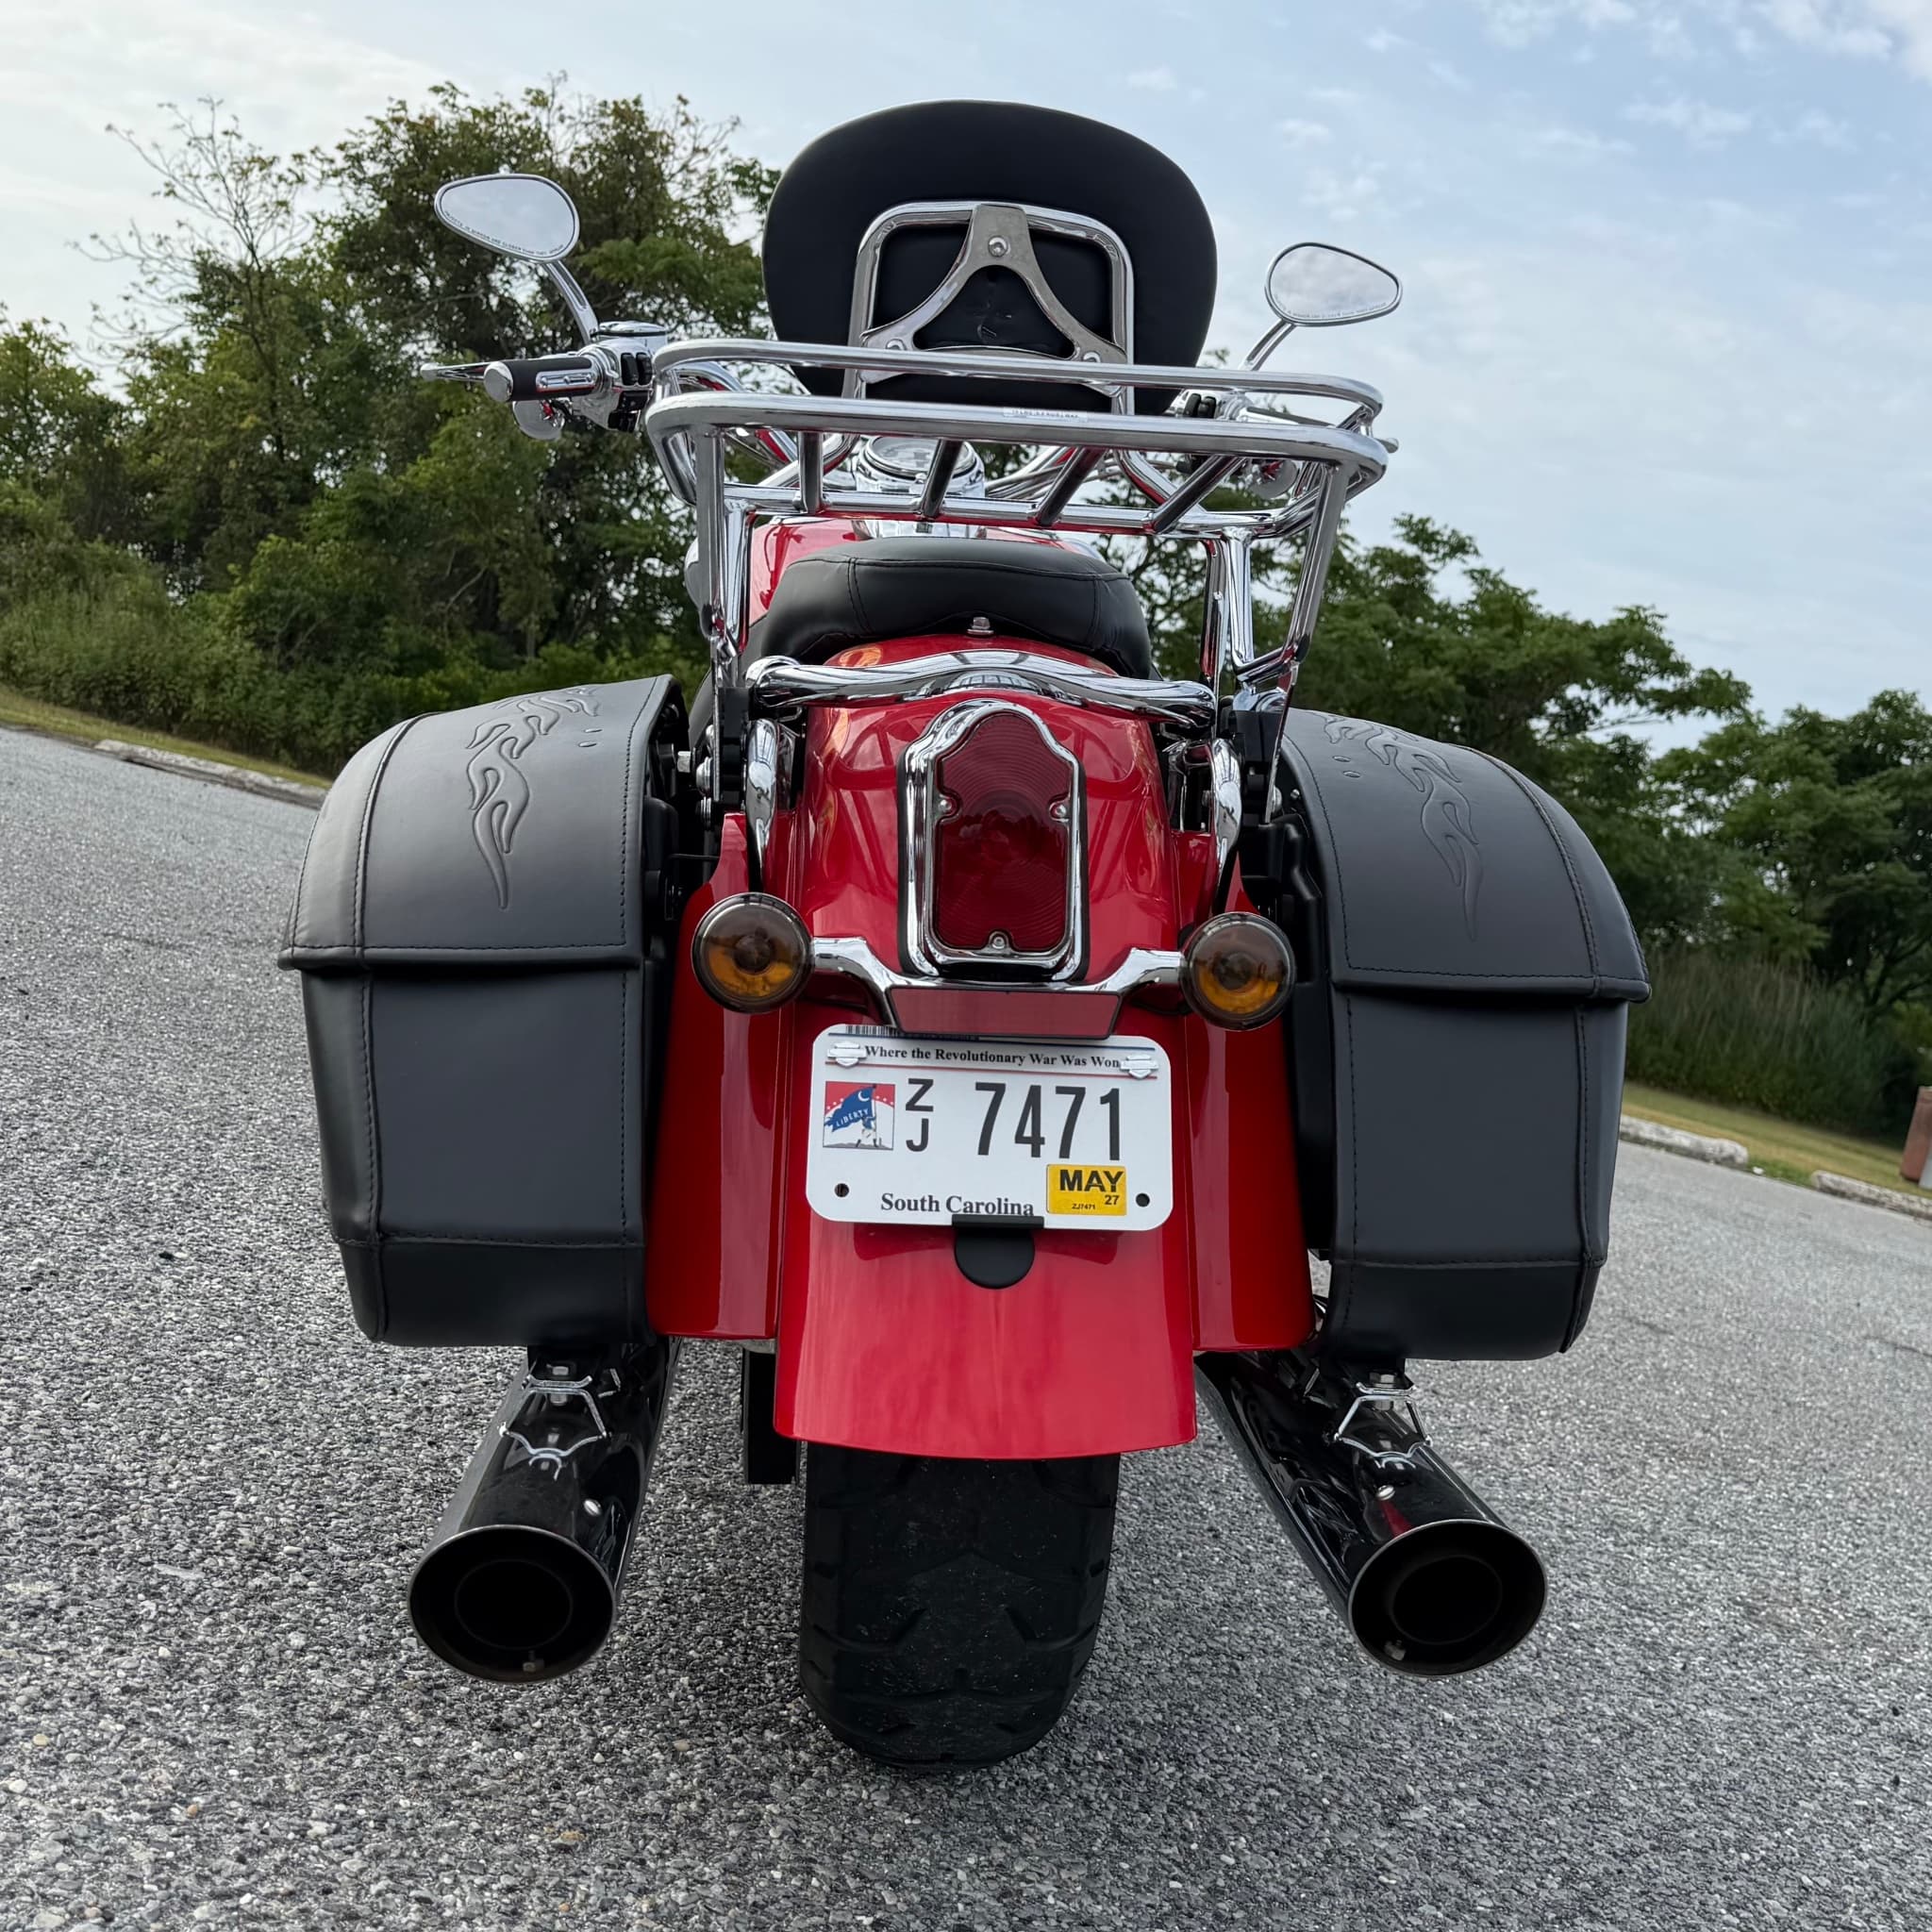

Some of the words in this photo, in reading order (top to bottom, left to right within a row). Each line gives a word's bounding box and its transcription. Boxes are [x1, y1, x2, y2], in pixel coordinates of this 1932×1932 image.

[865, 1045, 907, 1058] Where
[911, 1047, 931, 1059] the
[936, 1048, 1025, 1066] Revolutionary
[1029, 1053, 1057, 1065] War
[1060, 1055, 1087, 1066] Was
[1091, 1056, 1119, 1068] Won
[836, 1108, 869, 1127] LIBERTY
[974, 1081, 1120, 1160] 7471
[1059, 1169, 1124, 1192] MAY
[880, 1192, 941, 1212] South
[945, 1195, 1034, 1216] Carolina
[1105, 1194, 1120, 1206] 27
